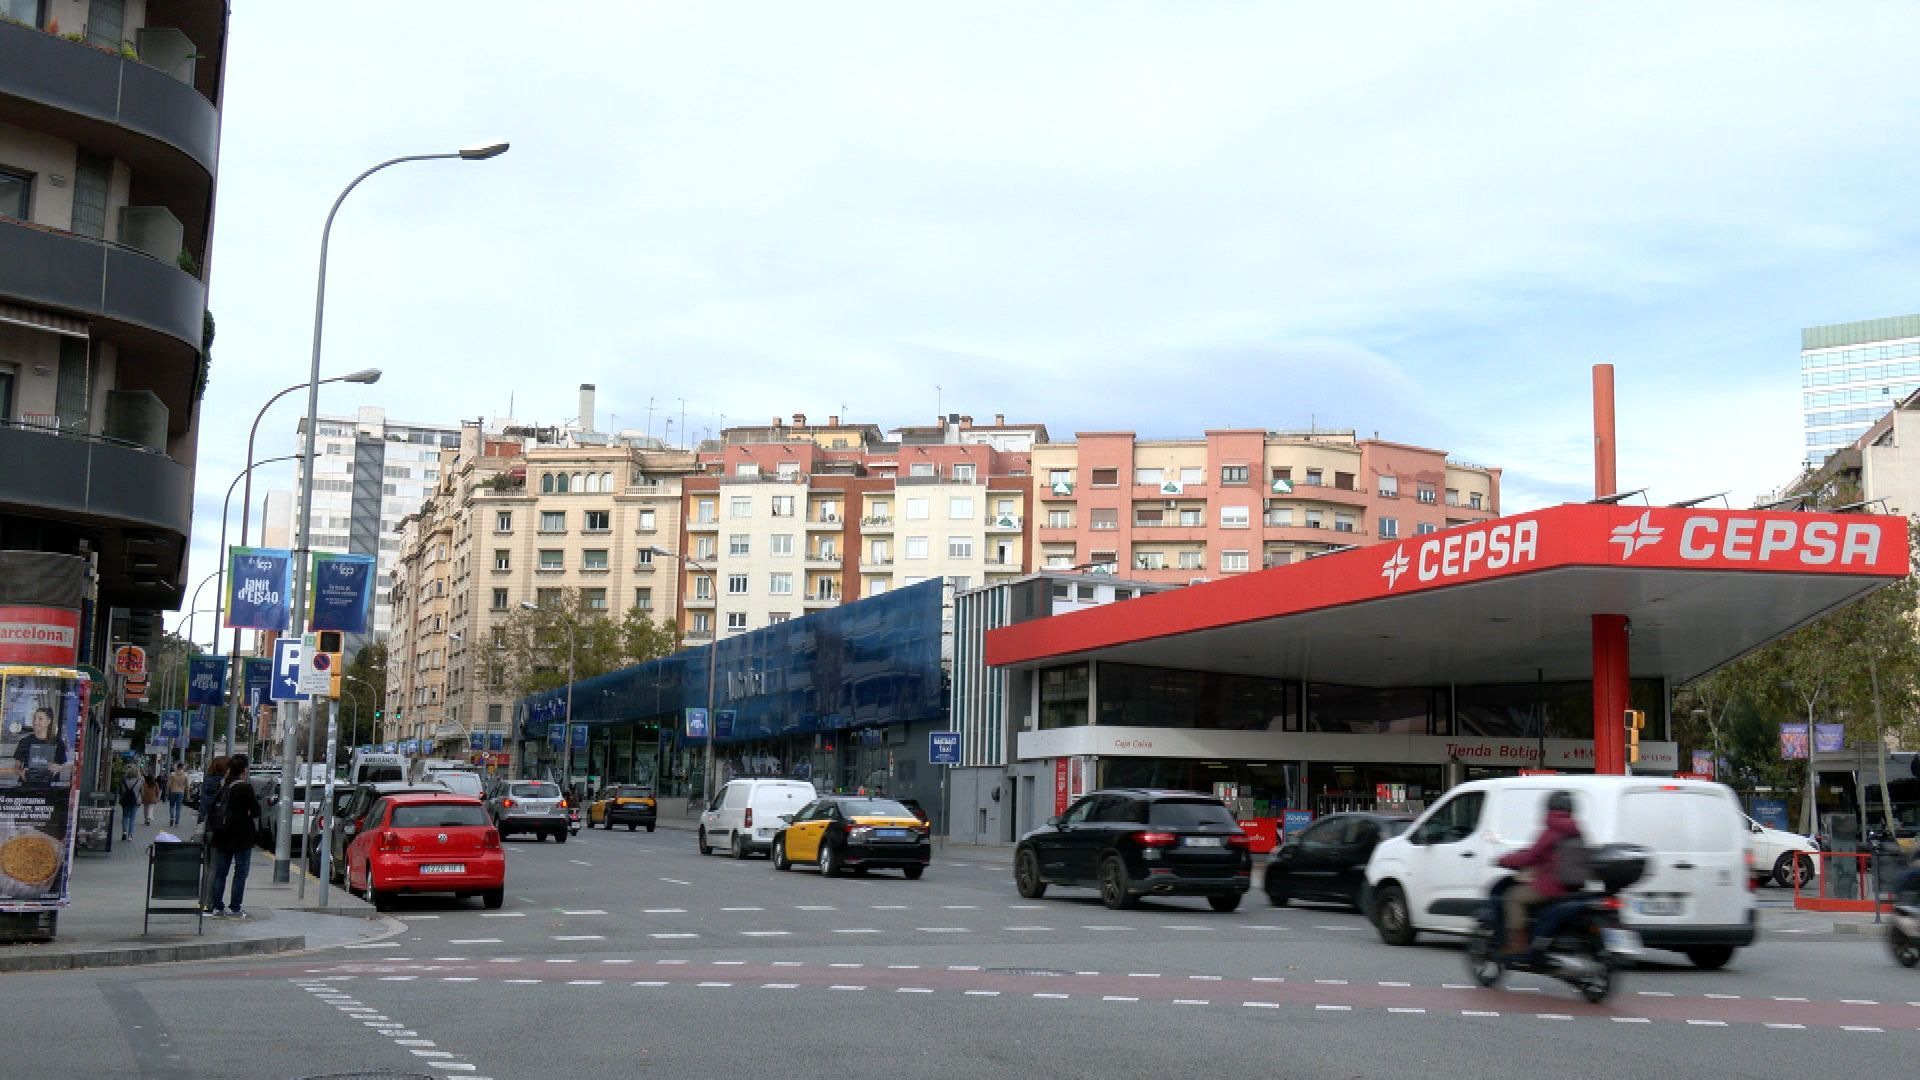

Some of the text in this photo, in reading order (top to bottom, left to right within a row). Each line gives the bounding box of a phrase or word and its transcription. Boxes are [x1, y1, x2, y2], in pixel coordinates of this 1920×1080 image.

[1418, 520, 1538, 582] CEPSA
[1679, 517, 1882, 566] CEPSA
[280, 643, 301, 676] P
[1446, 743, 1491, 758] Tienda
